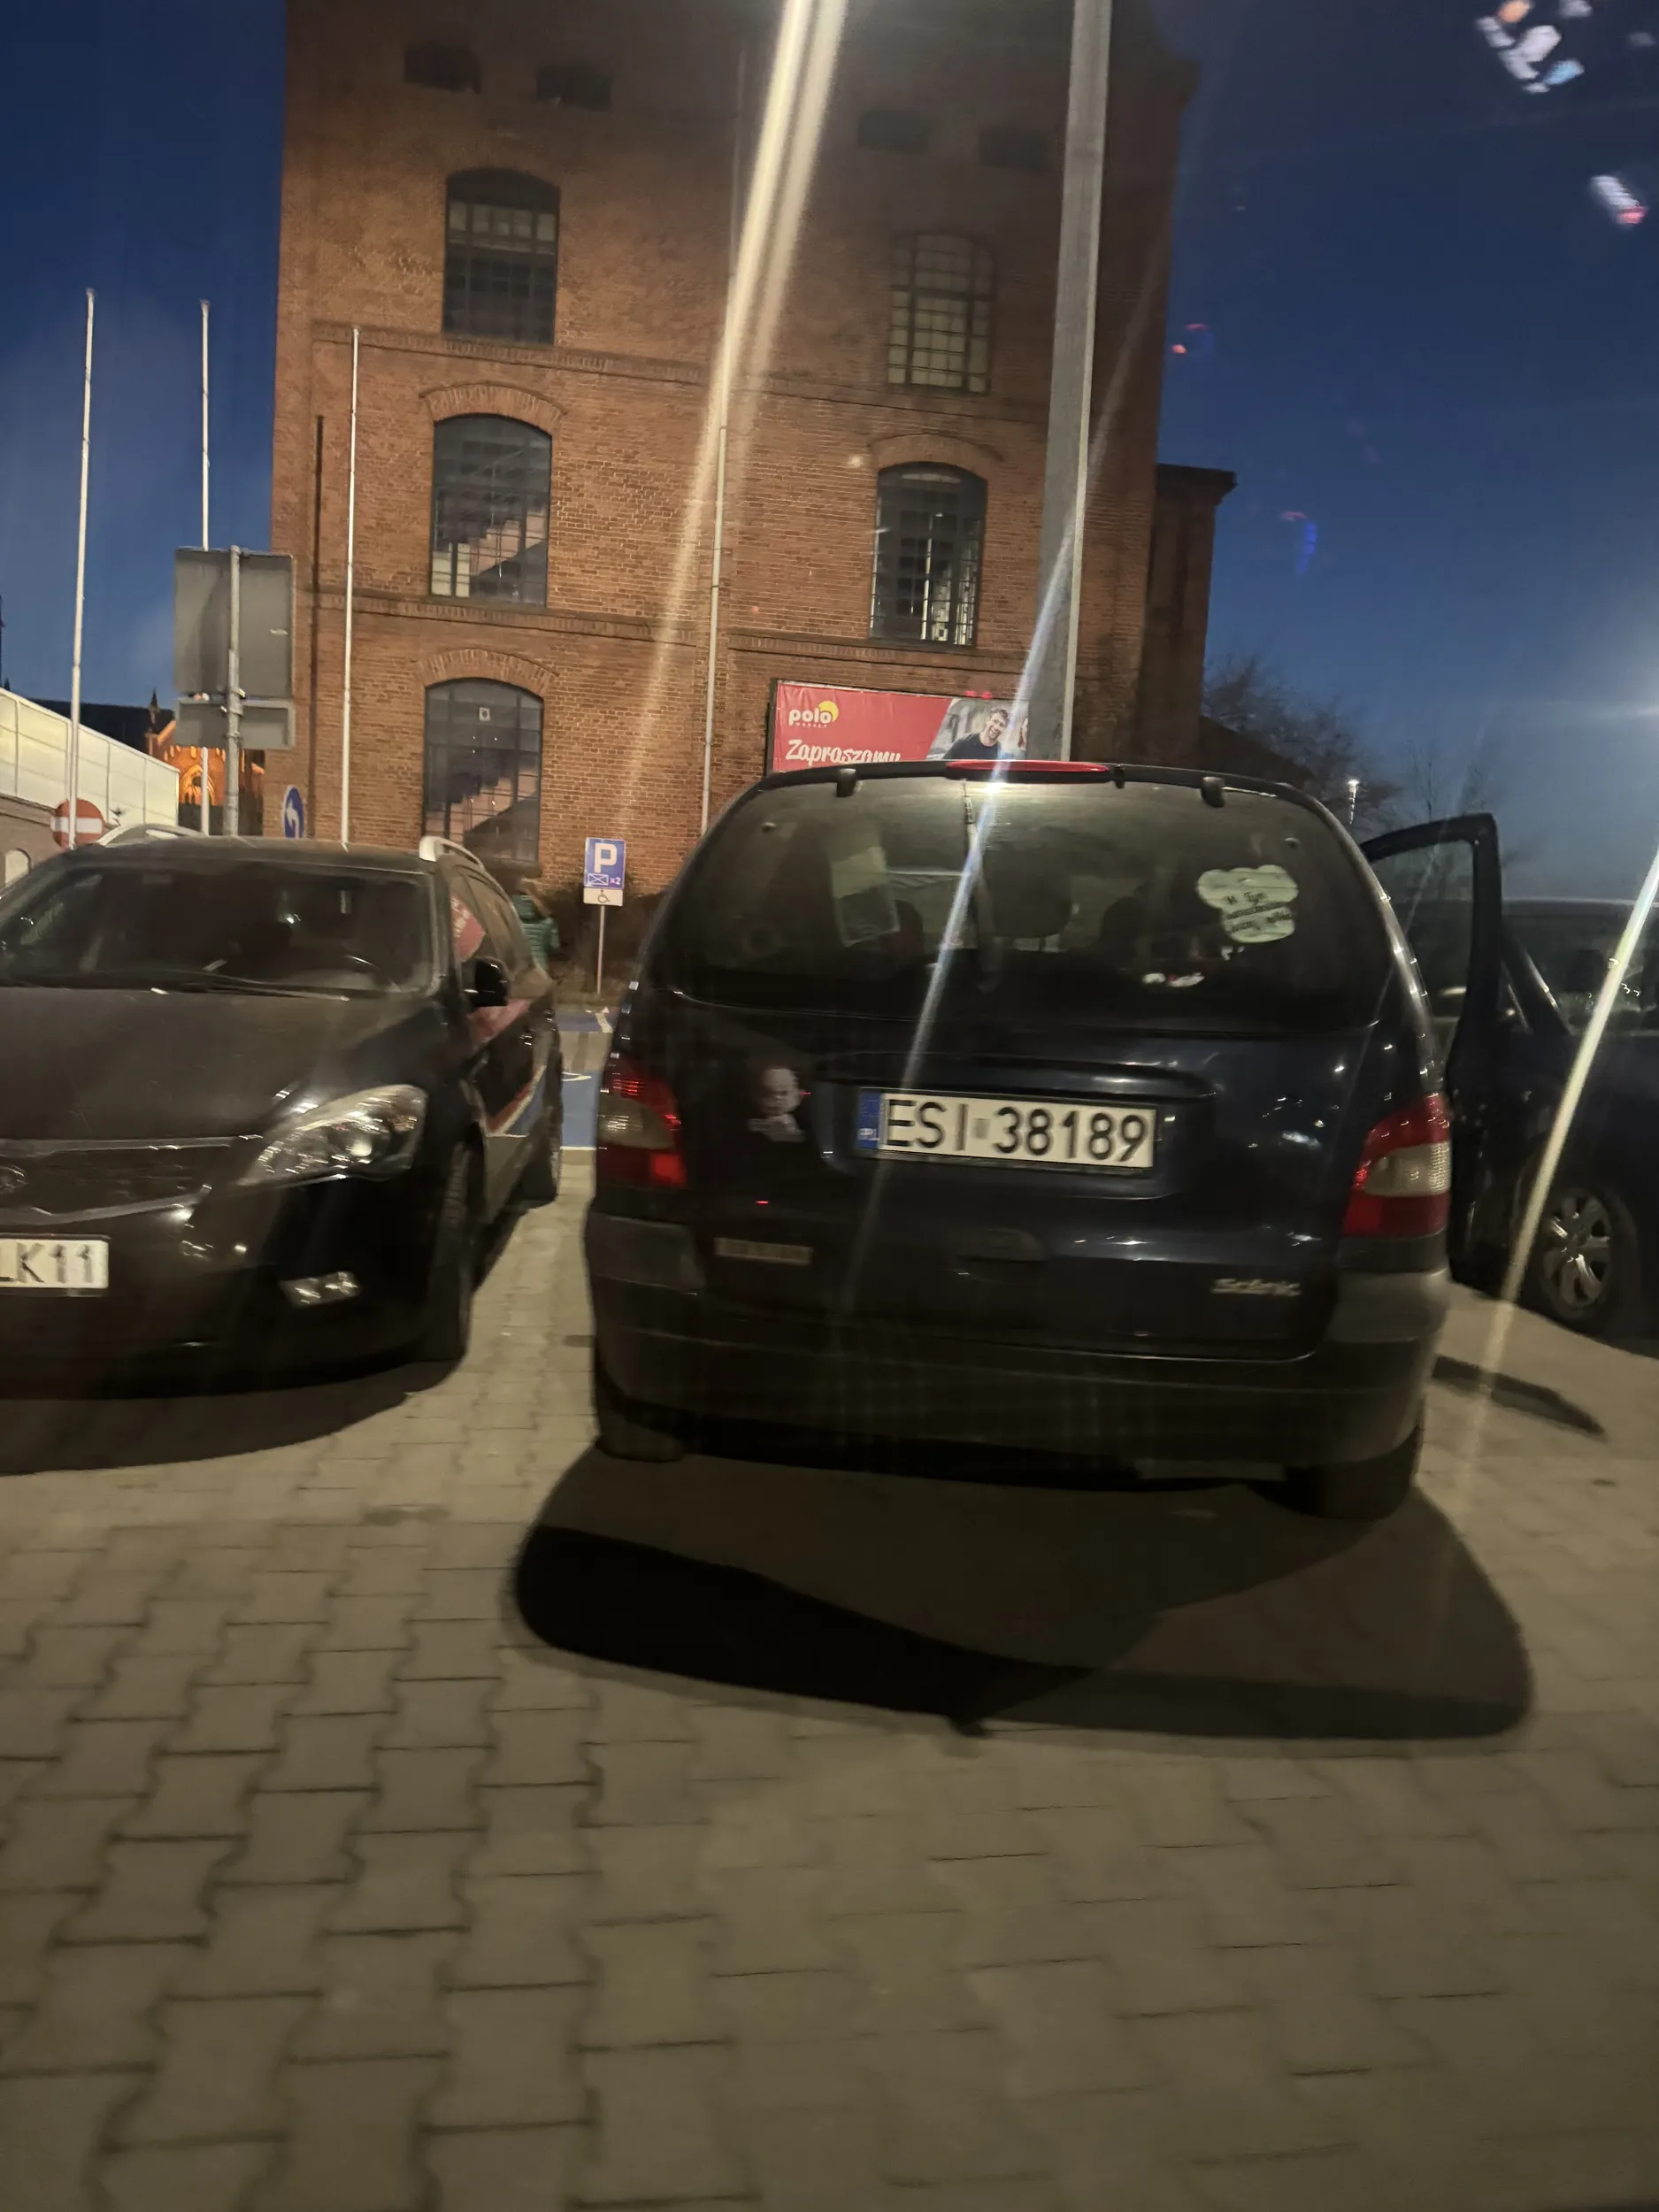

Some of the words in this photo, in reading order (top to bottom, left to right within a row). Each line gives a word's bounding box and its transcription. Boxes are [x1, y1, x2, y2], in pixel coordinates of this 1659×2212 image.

[788, 707, 832, 726] polo
[594, 842, 618, 874] P
[886, 1099, 969, 1151] ESI
[993, 1106, 1149, 1162] 38189
